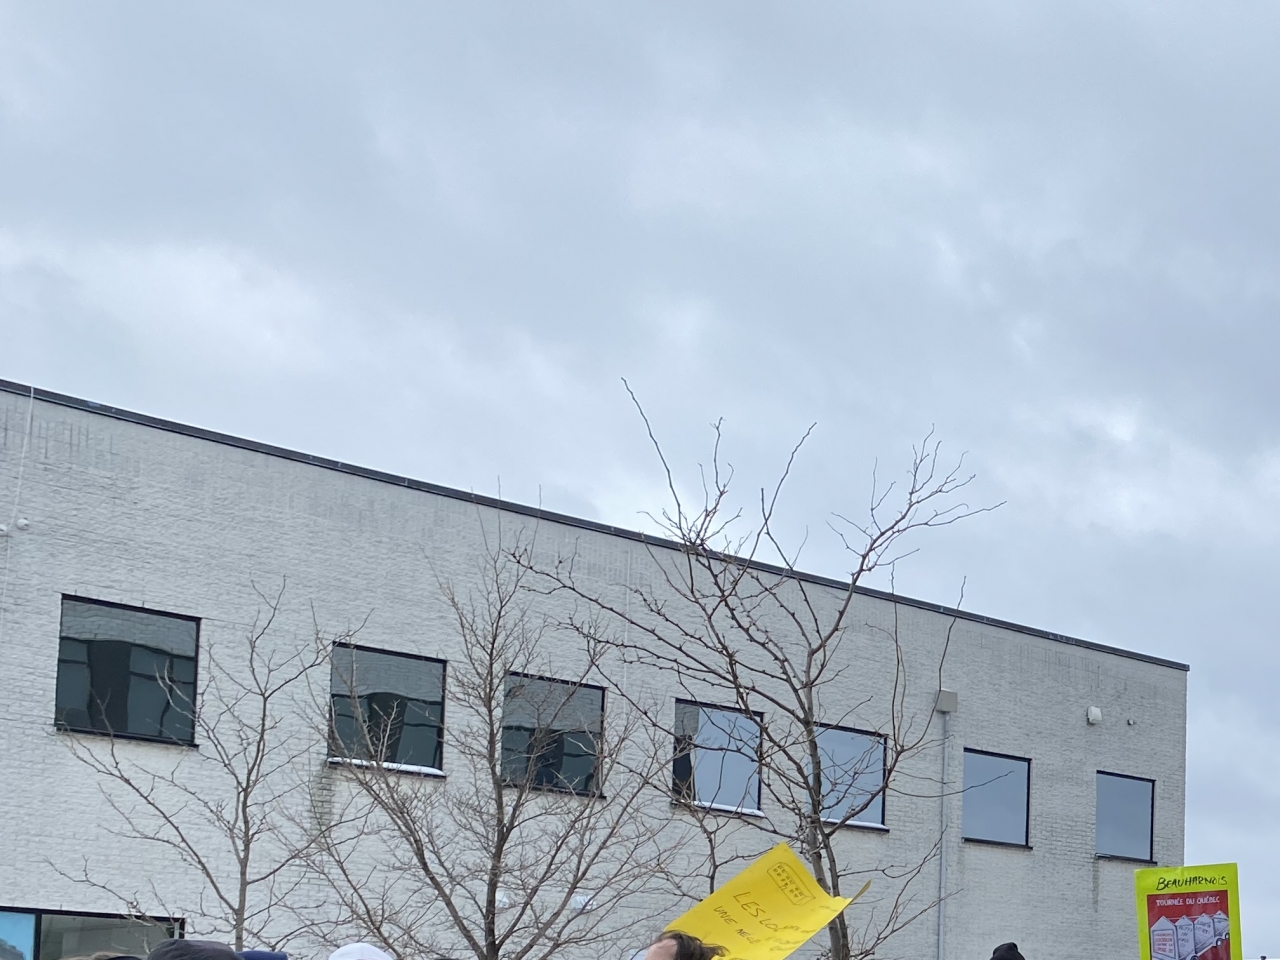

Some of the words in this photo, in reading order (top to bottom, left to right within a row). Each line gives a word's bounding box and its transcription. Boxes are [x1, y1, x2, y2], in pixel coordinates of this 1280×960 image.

[733, 891, 766, 918] LES
[1156, 897, 1184, 906] TOURNÉE
[1196, 895, 1220, 905] QUÉBEC
[714, 905, 738, 925] UNE
